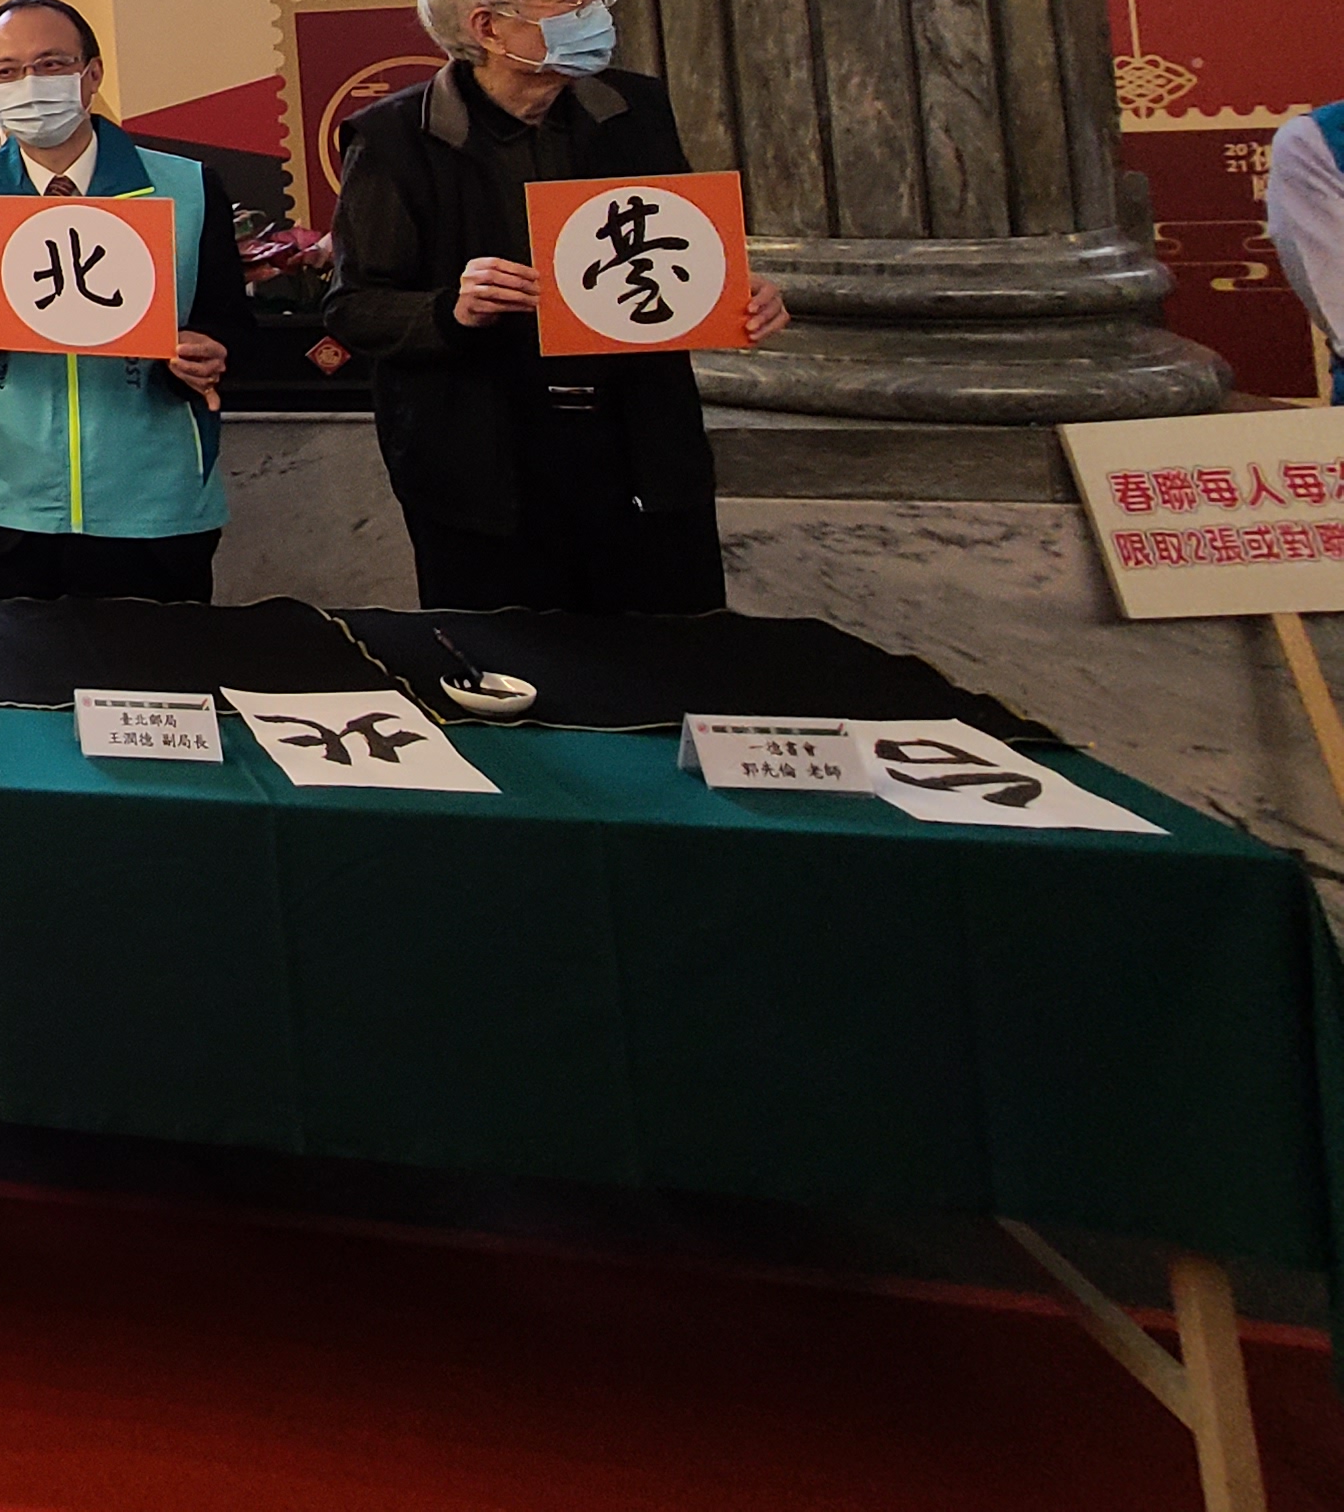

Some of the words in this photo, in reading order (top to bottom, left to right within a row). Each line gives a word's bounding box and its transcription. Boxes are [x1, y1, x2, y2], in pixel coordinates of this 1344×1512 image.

[33, 227, 123, 309] 北
[119, 711, 177, 728] 臺北郵局
[162, 732, 210, 750] 副局長
[808, 762, 843, 780] 老師
